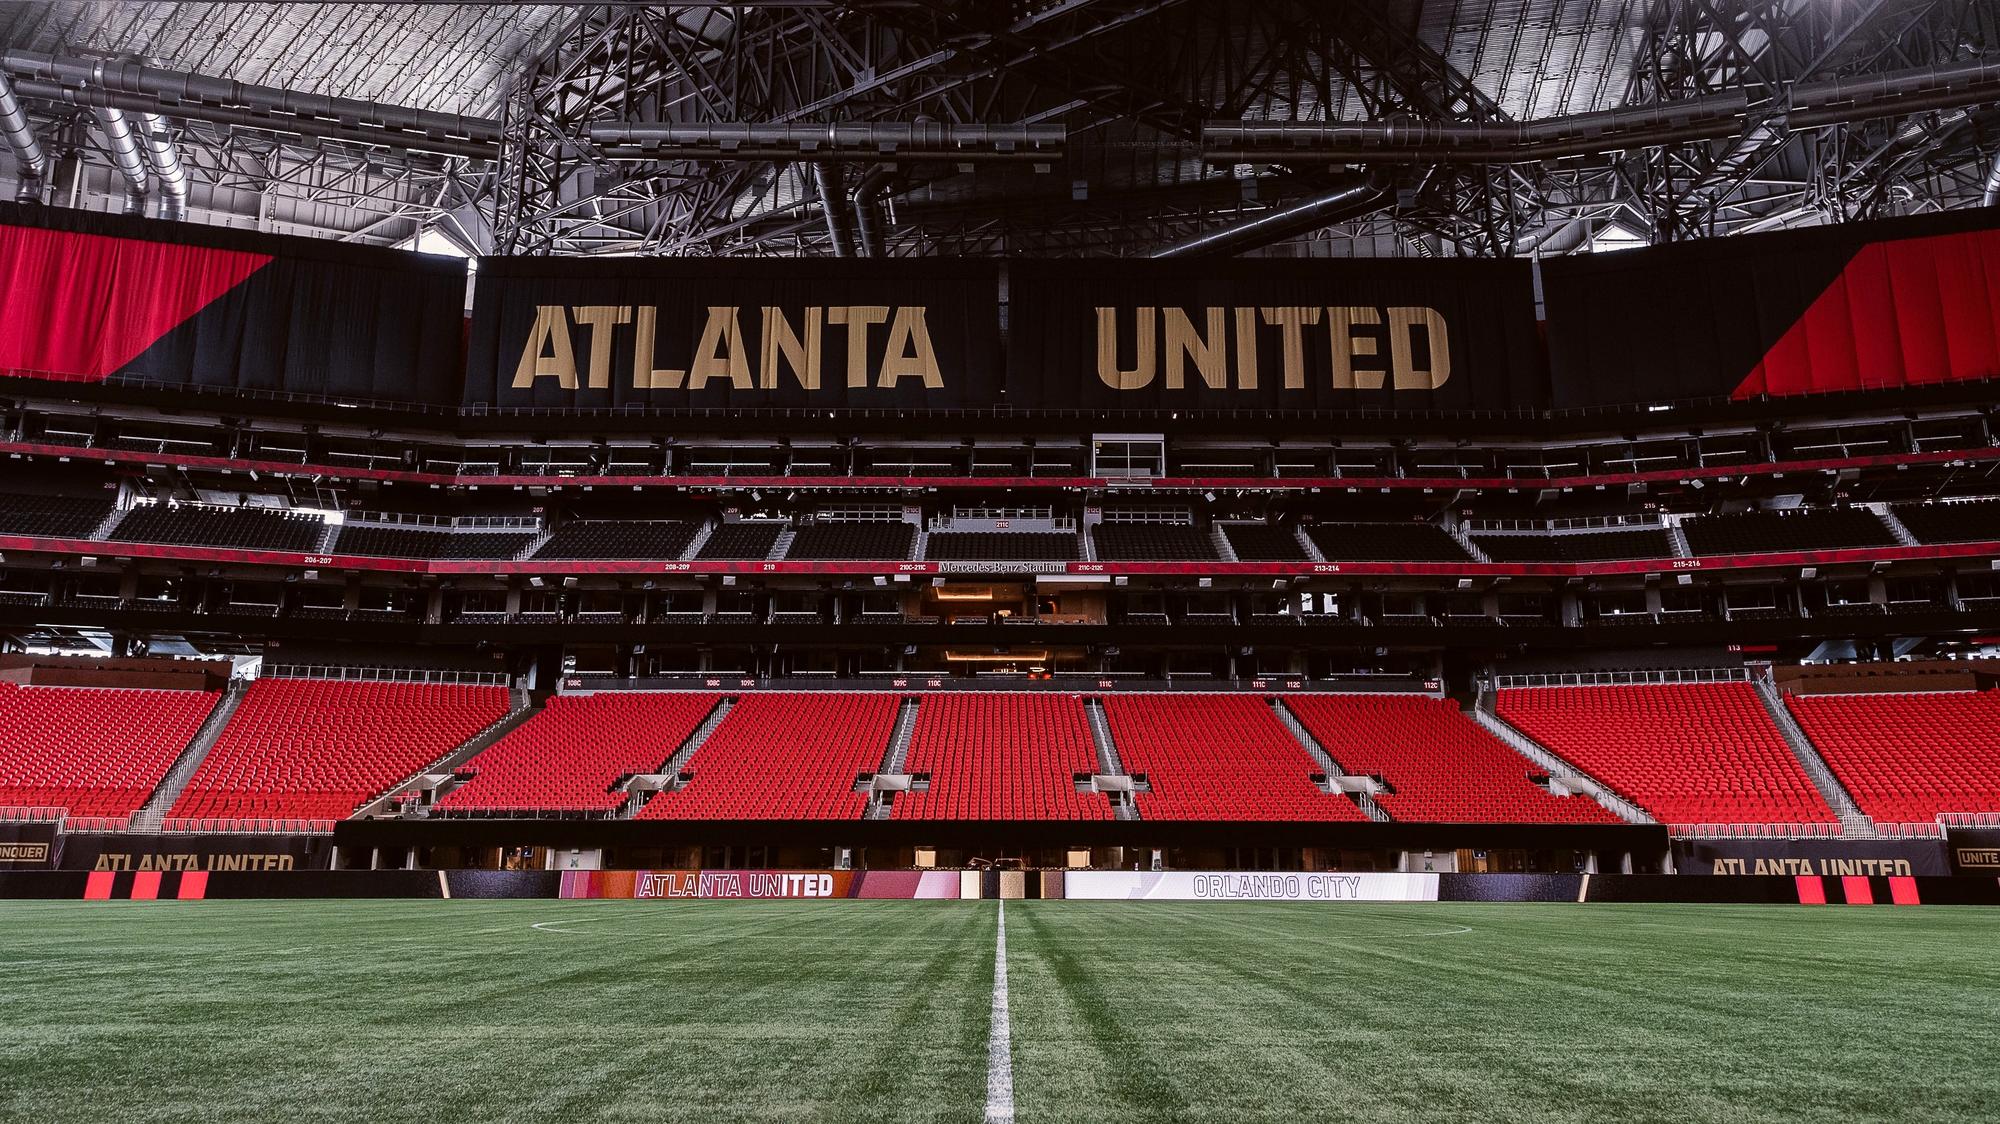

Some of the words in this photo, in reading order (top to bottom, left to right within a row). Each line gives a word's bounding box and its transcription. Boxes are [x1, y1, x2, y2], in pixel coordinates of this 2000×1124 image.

[511, 305, 945, 390] ATLANTA
[1095, 306, 1451, 390] UNITED
[304, 556, 332, 565] 206-207
[1672, 560, 1701, 568] 215-216
[665, 563, 690, 571] 208-209
[763, 563, 776, 571] 210
[899, 563, 927, 571] 210C-211C
[941, 562, 1019, 573] Mercedes-Benz
[1022, 562, 1066, 573] Stadium
[1314, 564, 1340, 572] 213-214
[1099, 680, 1112, 688] 111C
[1286, 681, 1301, 689] 112C
[0, 846, 44, 859] NQUER
[94, 853, 200, 872] ATLANTA
[207, 854, 294, 872] UNITED
[1961, 852, 1999, 864] UNITE
[1713, 858, 1815, 876] ATLANTA
[1820, 858, 1912, 876] UNITED
[639, 873, 742, 897] ATLANTA
[750, 873, 833, 897] UNITED
[1193, 874, 1300, 898] ORLANDO
[1307, 875, 1361, 898] CITY
